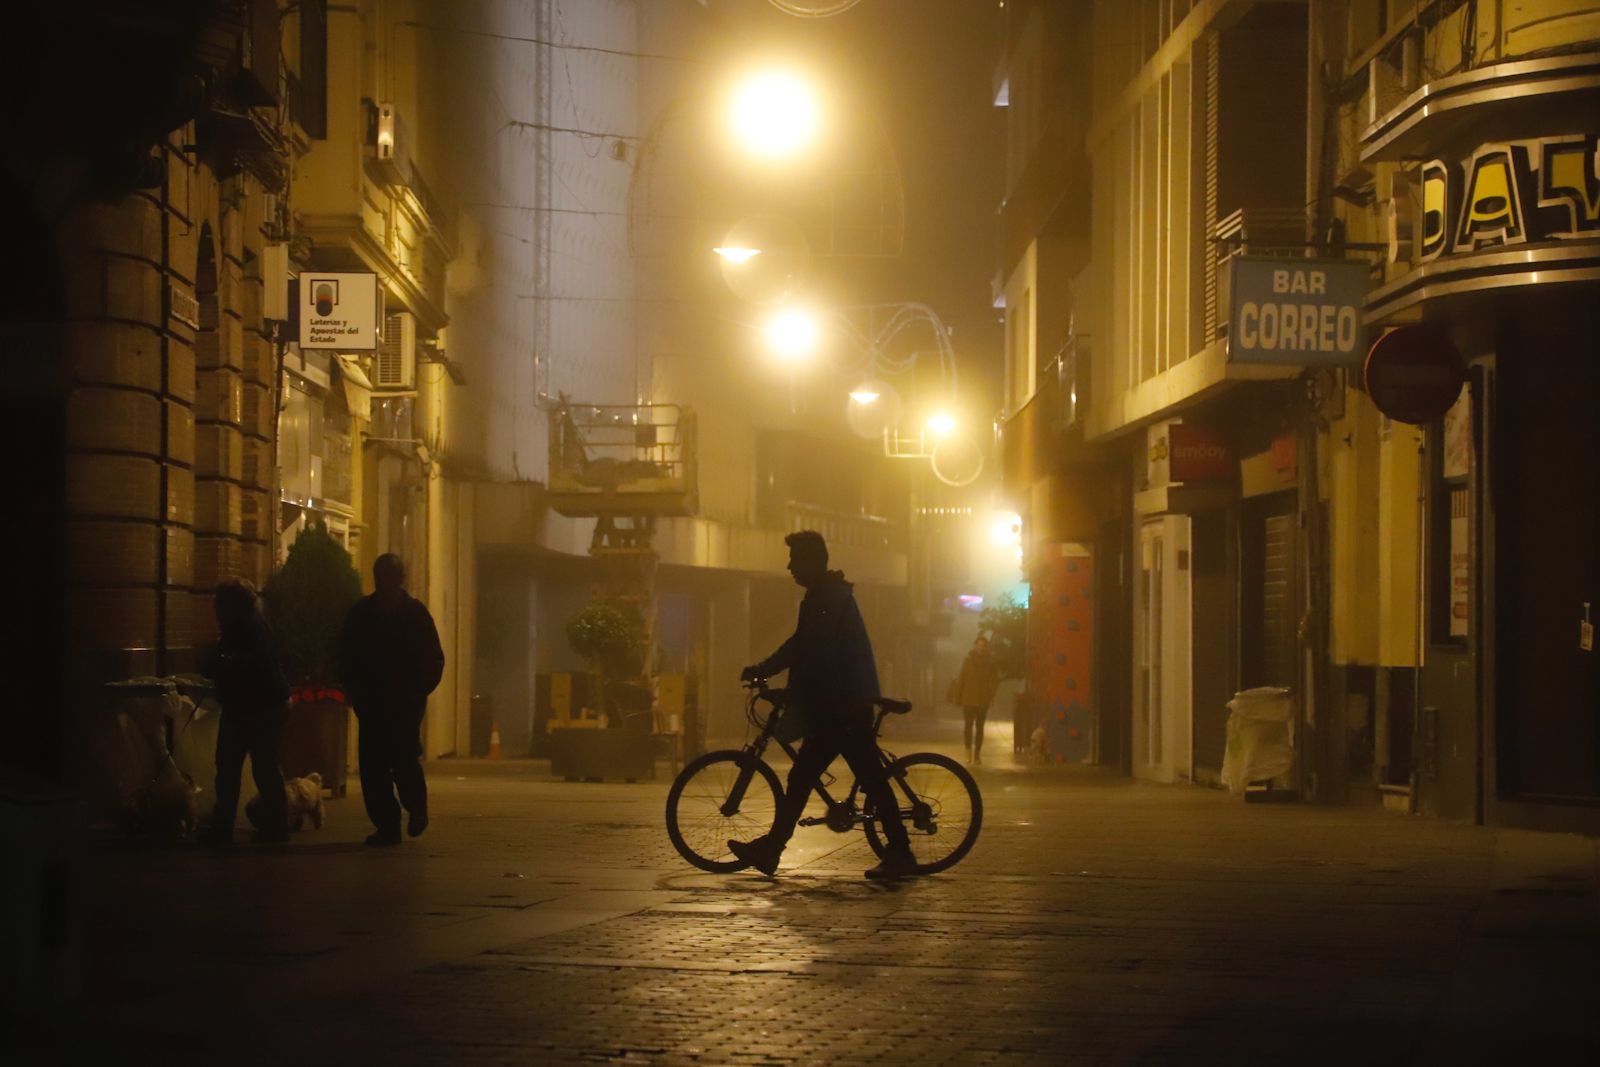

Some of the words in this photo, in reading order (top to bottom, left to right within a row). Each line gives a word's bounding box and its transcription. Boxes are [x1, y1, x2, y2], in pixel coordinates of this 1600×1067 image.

[1273, 270, 1326, 294] BAR
[310, 328, 346, 336] Apuestas
[1240, 301, 1357, 353] CORREO
